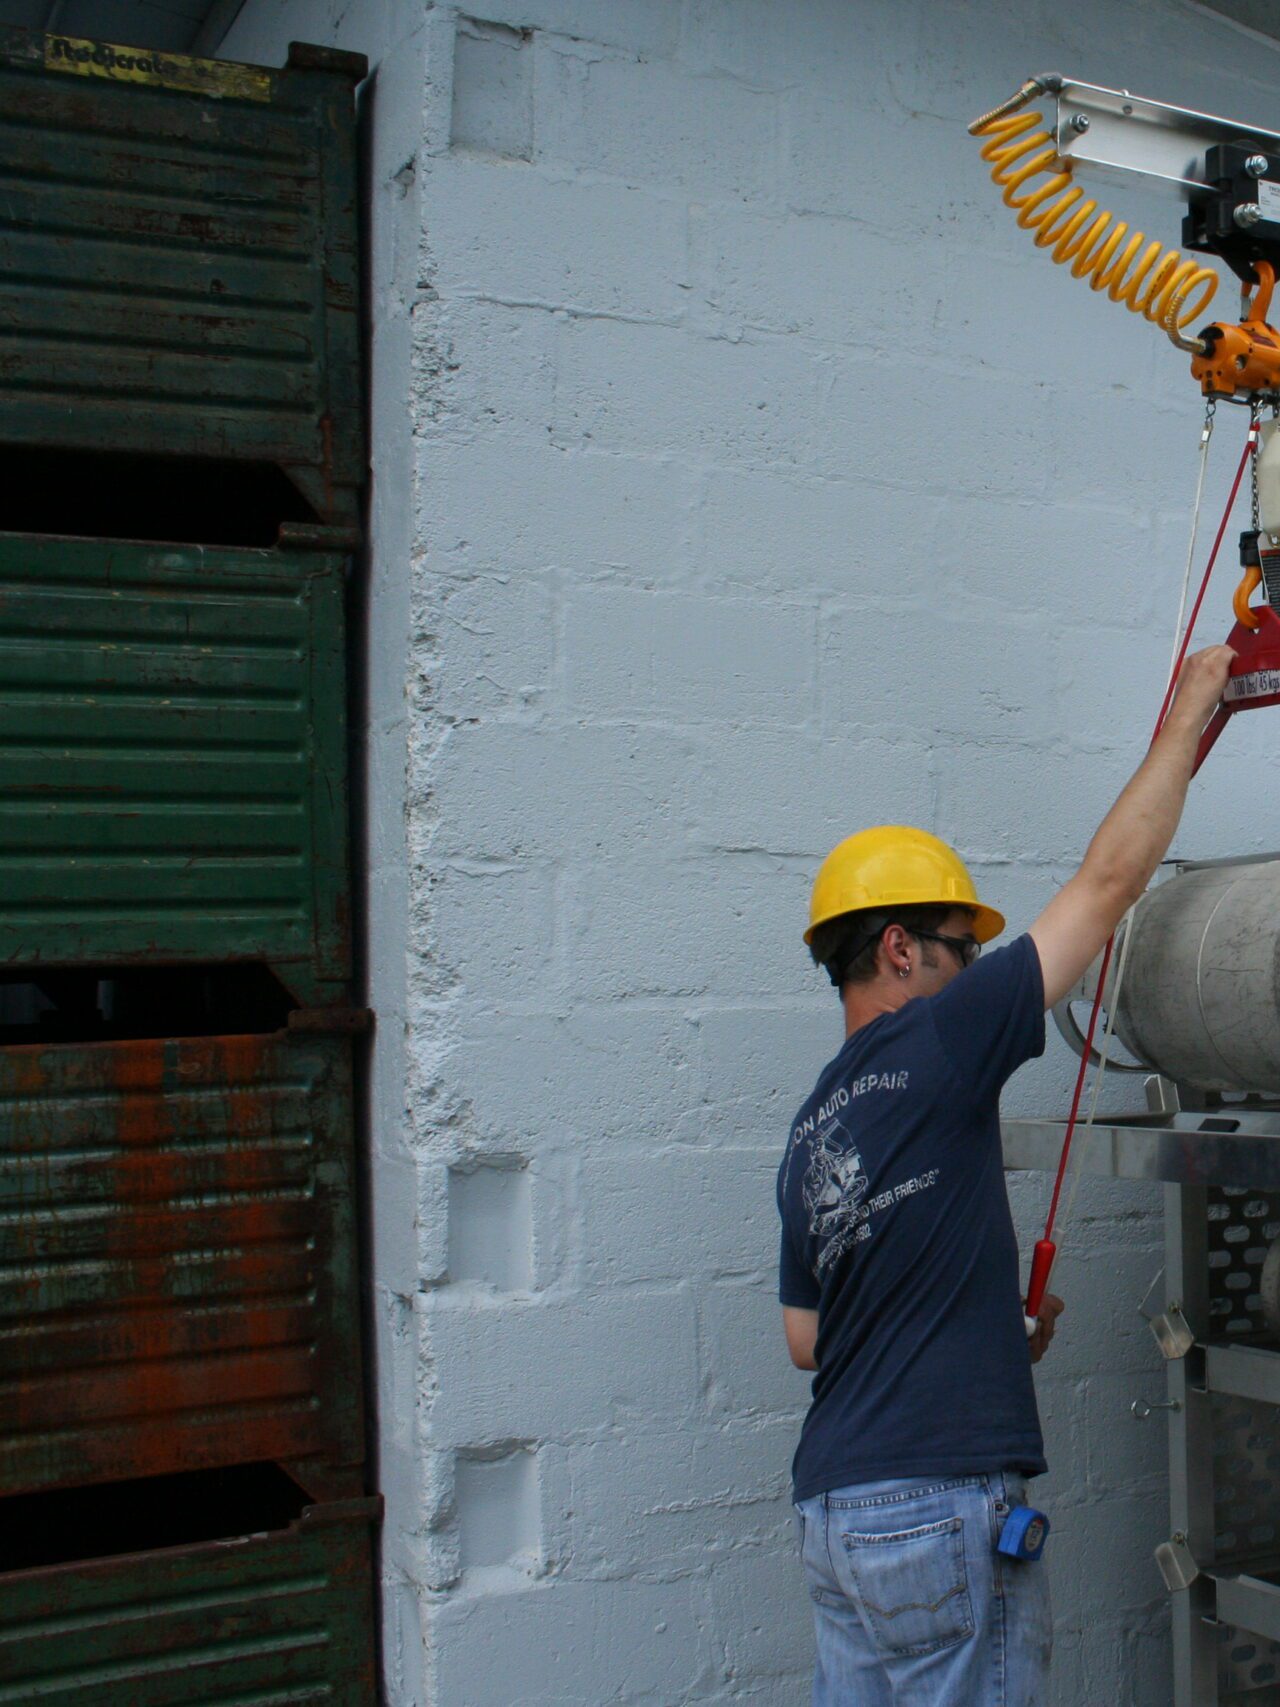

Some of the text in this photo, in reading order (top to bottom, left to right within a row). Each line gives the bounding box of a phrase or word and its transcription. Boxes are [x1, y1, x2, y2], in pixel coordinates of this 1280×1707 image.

[1234, 679, 1246, 697] 100
[1259, 674, 1268, 692] 45
[817, 1087, 849, 1125] AUTO
[852, 1070, 909, 1098] REPAIR
[868, 1190, 895, 1213] THEIR
[893, 1167, 940, 1201] FRIENDS"
